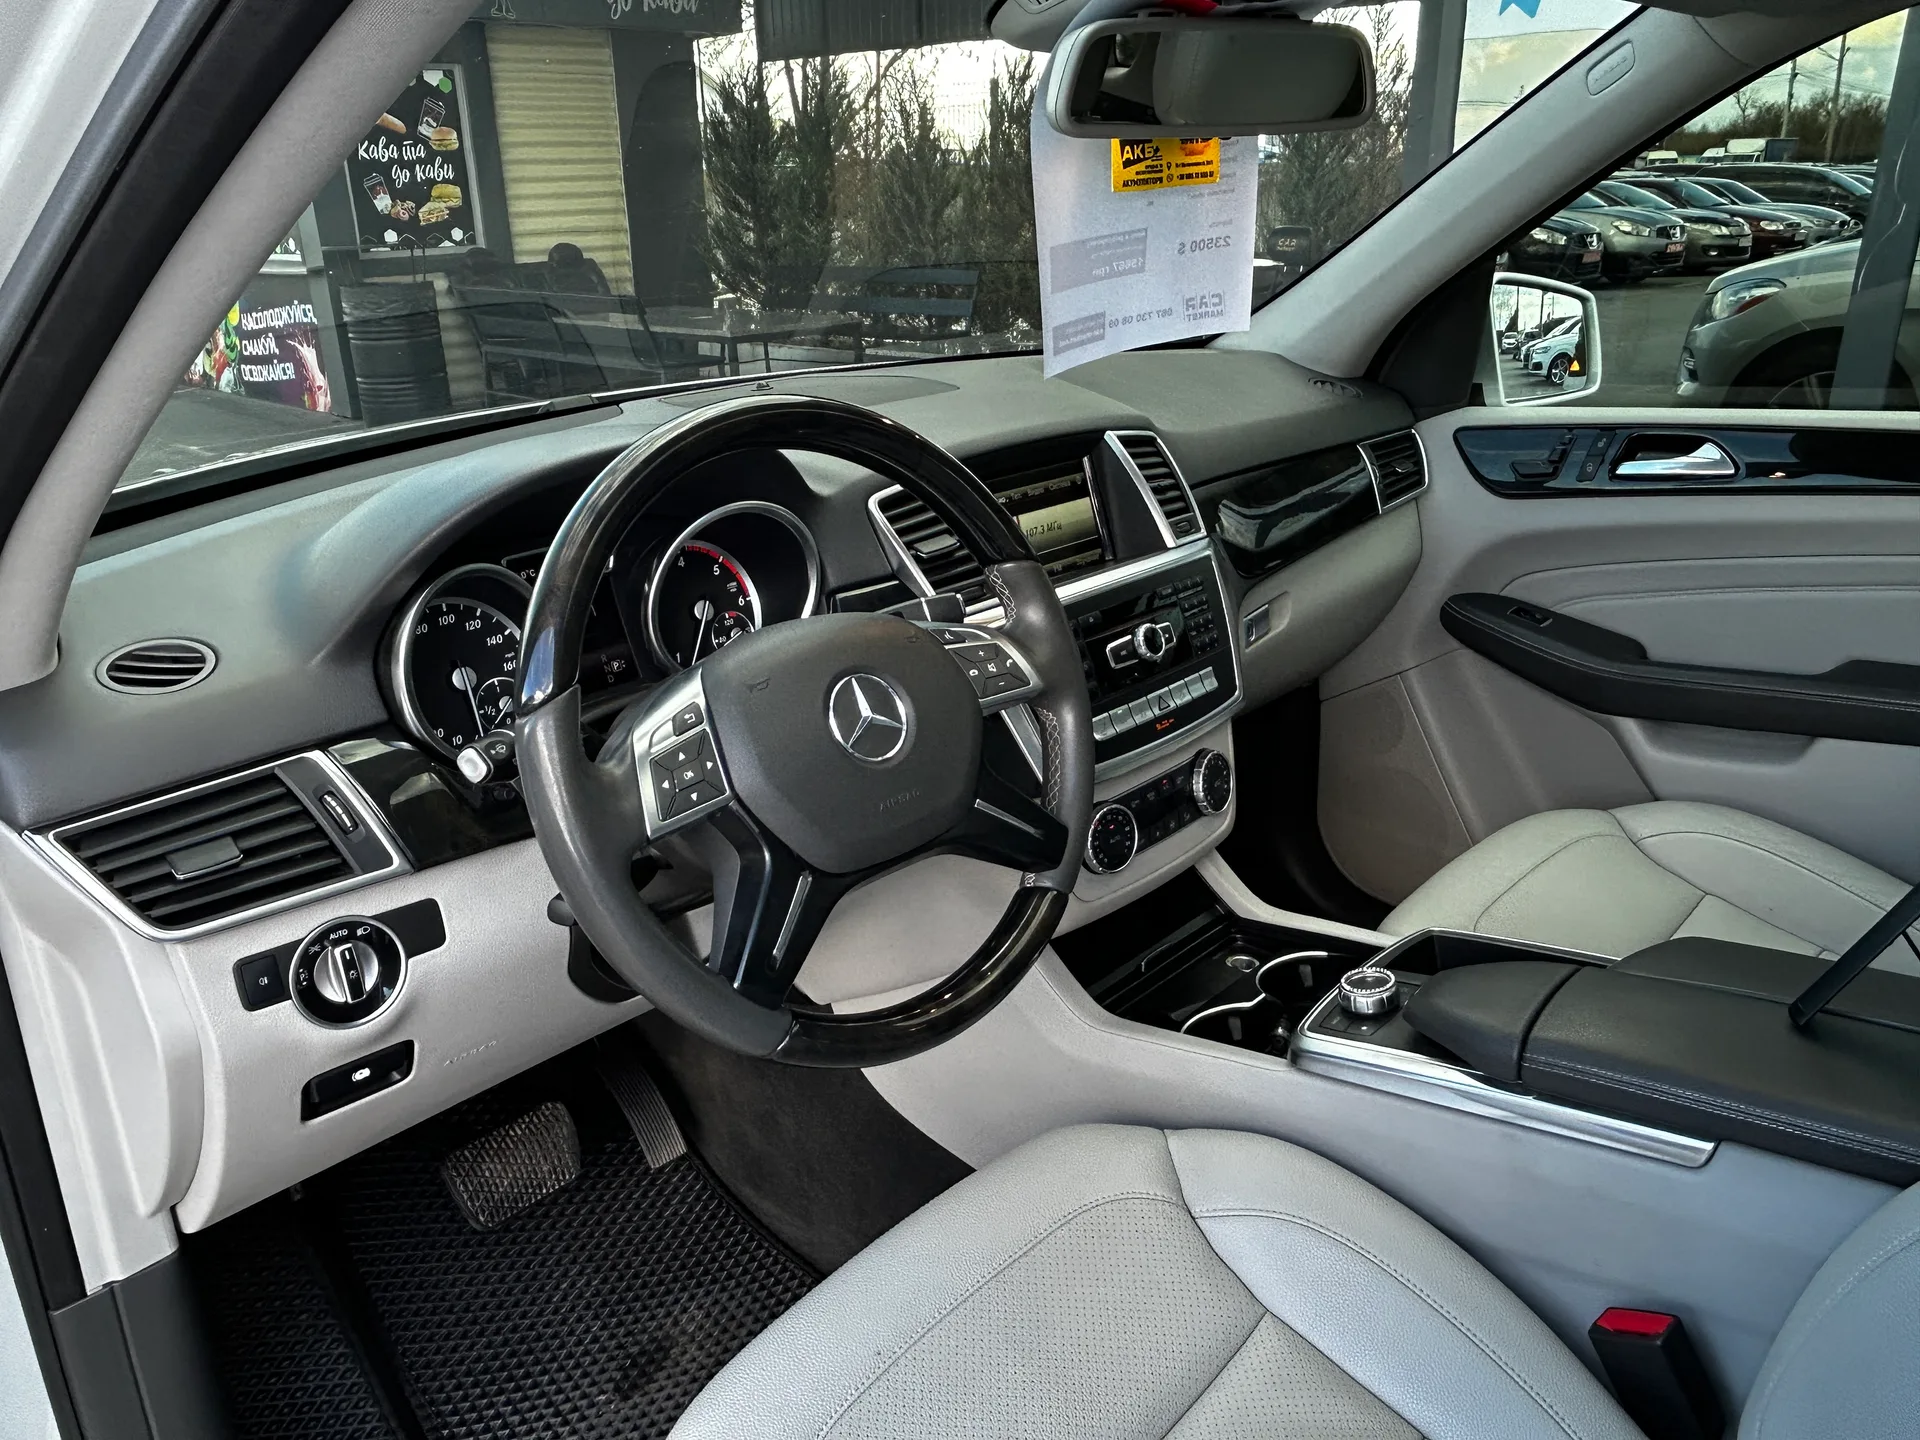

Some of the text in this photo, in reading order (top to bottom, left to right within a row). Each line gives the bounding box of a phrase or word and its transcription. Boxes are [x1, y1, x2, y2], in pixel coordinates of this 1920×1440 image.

[358, 136, 399, 162] Кава
[391, 156, 455, 188] до кави
[713, 565, 720, 575] 5
[738, 596, 745, 606] 6
[438, 613, 455, 626] 100
[465, 619, 482, 632] 120
[486, 633, 503, 647] 140
[452, 735, 463, 746] 10
[329, 928, 348, 940] AUTO
